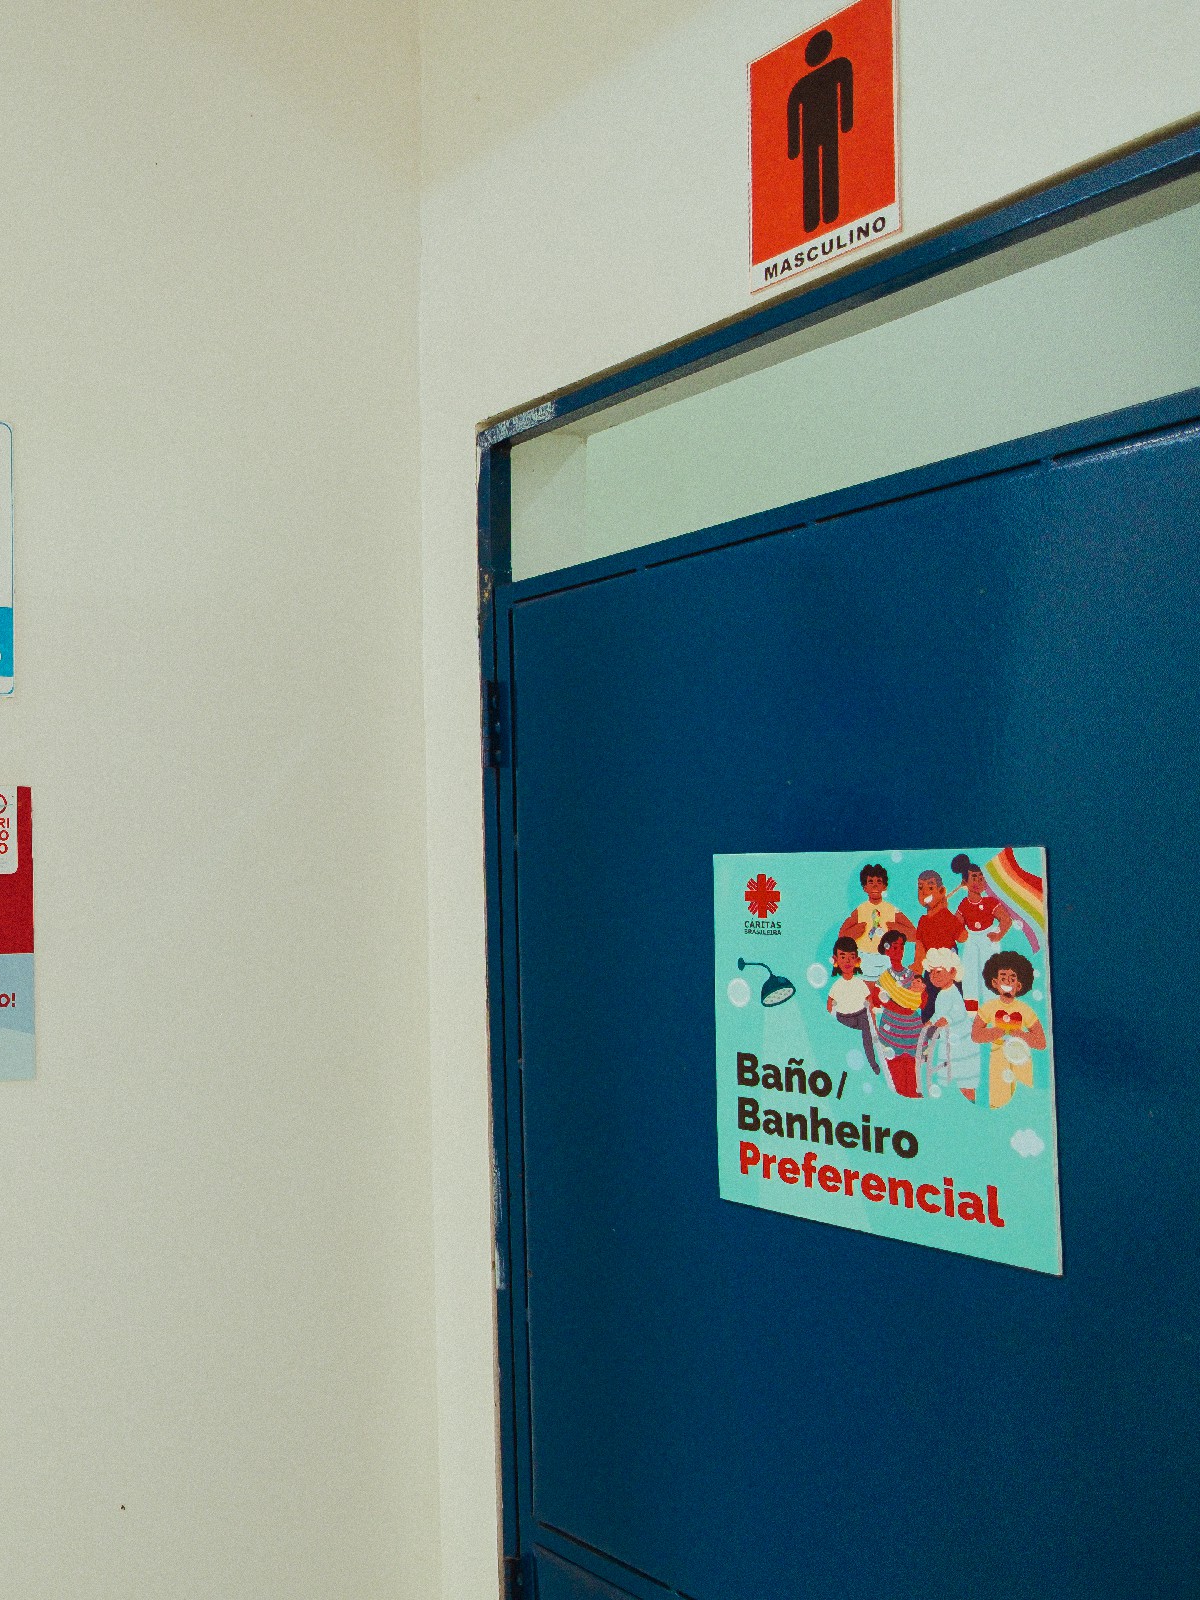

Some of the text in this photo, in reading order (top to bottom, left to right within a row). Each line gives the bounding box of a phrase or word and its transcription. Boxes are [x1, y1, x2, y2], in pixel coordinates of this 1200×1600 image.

[764, 216, 886, 281] MASCULINO
[744, 917, 782, 929] CÁRITAS
[737, 1097, 919, 1159] Banheiro
[739, 1141, 1005, 1228] Preferencial
